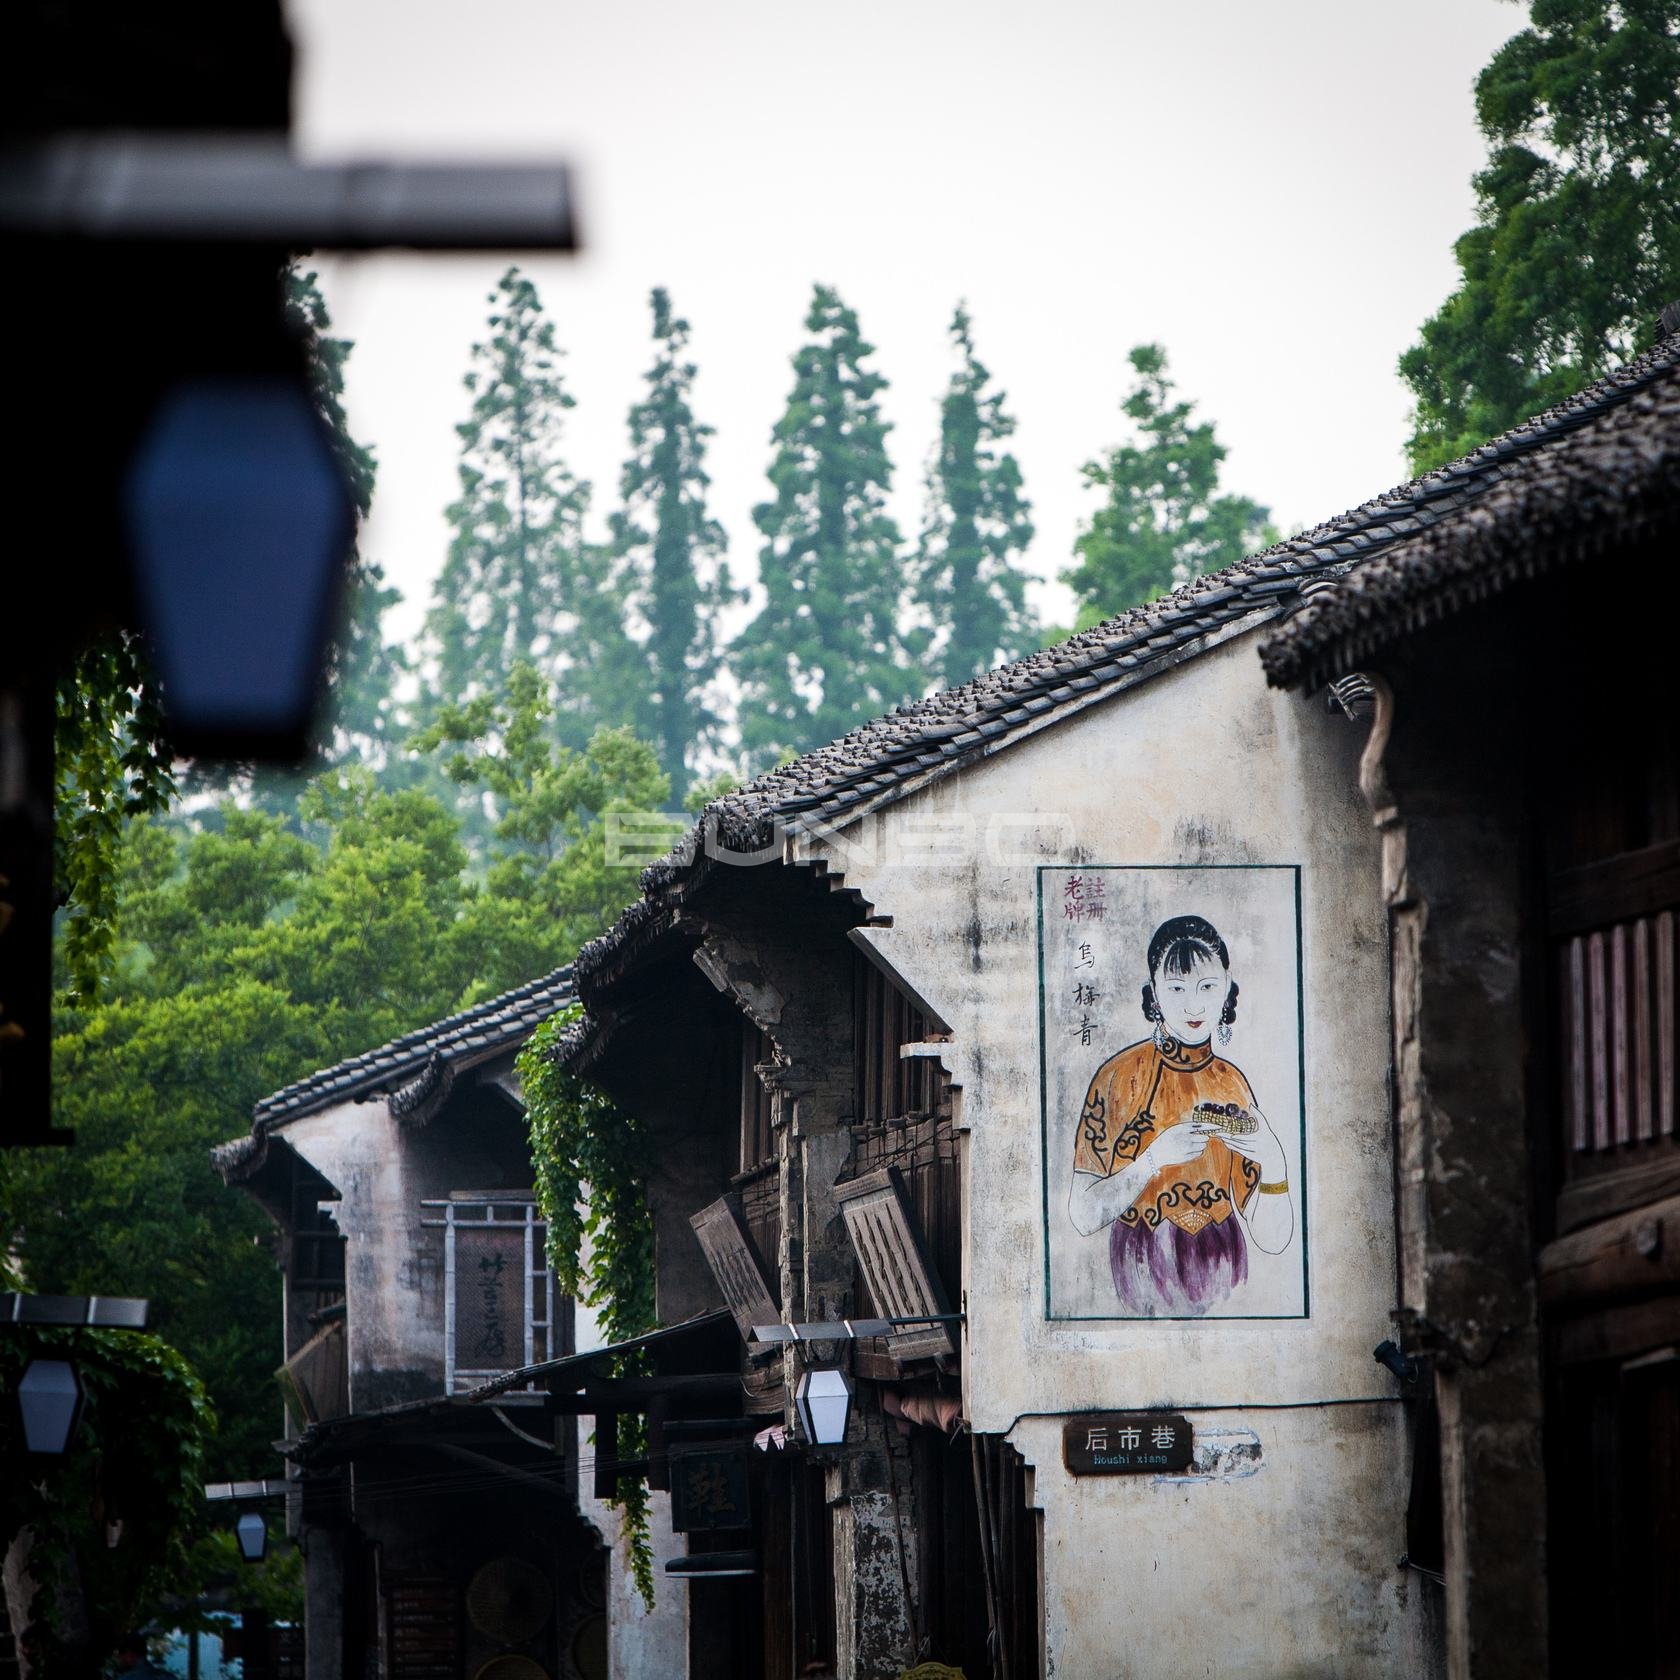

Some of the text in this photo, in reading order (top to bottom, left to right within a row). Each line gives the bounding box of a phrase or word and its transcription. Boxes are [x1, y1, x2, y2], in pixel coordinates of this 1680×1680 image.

[1085, 1425, 1176, 1451] 后市巷
[1094, 1453, 1168, 1465] Houshi xiang
